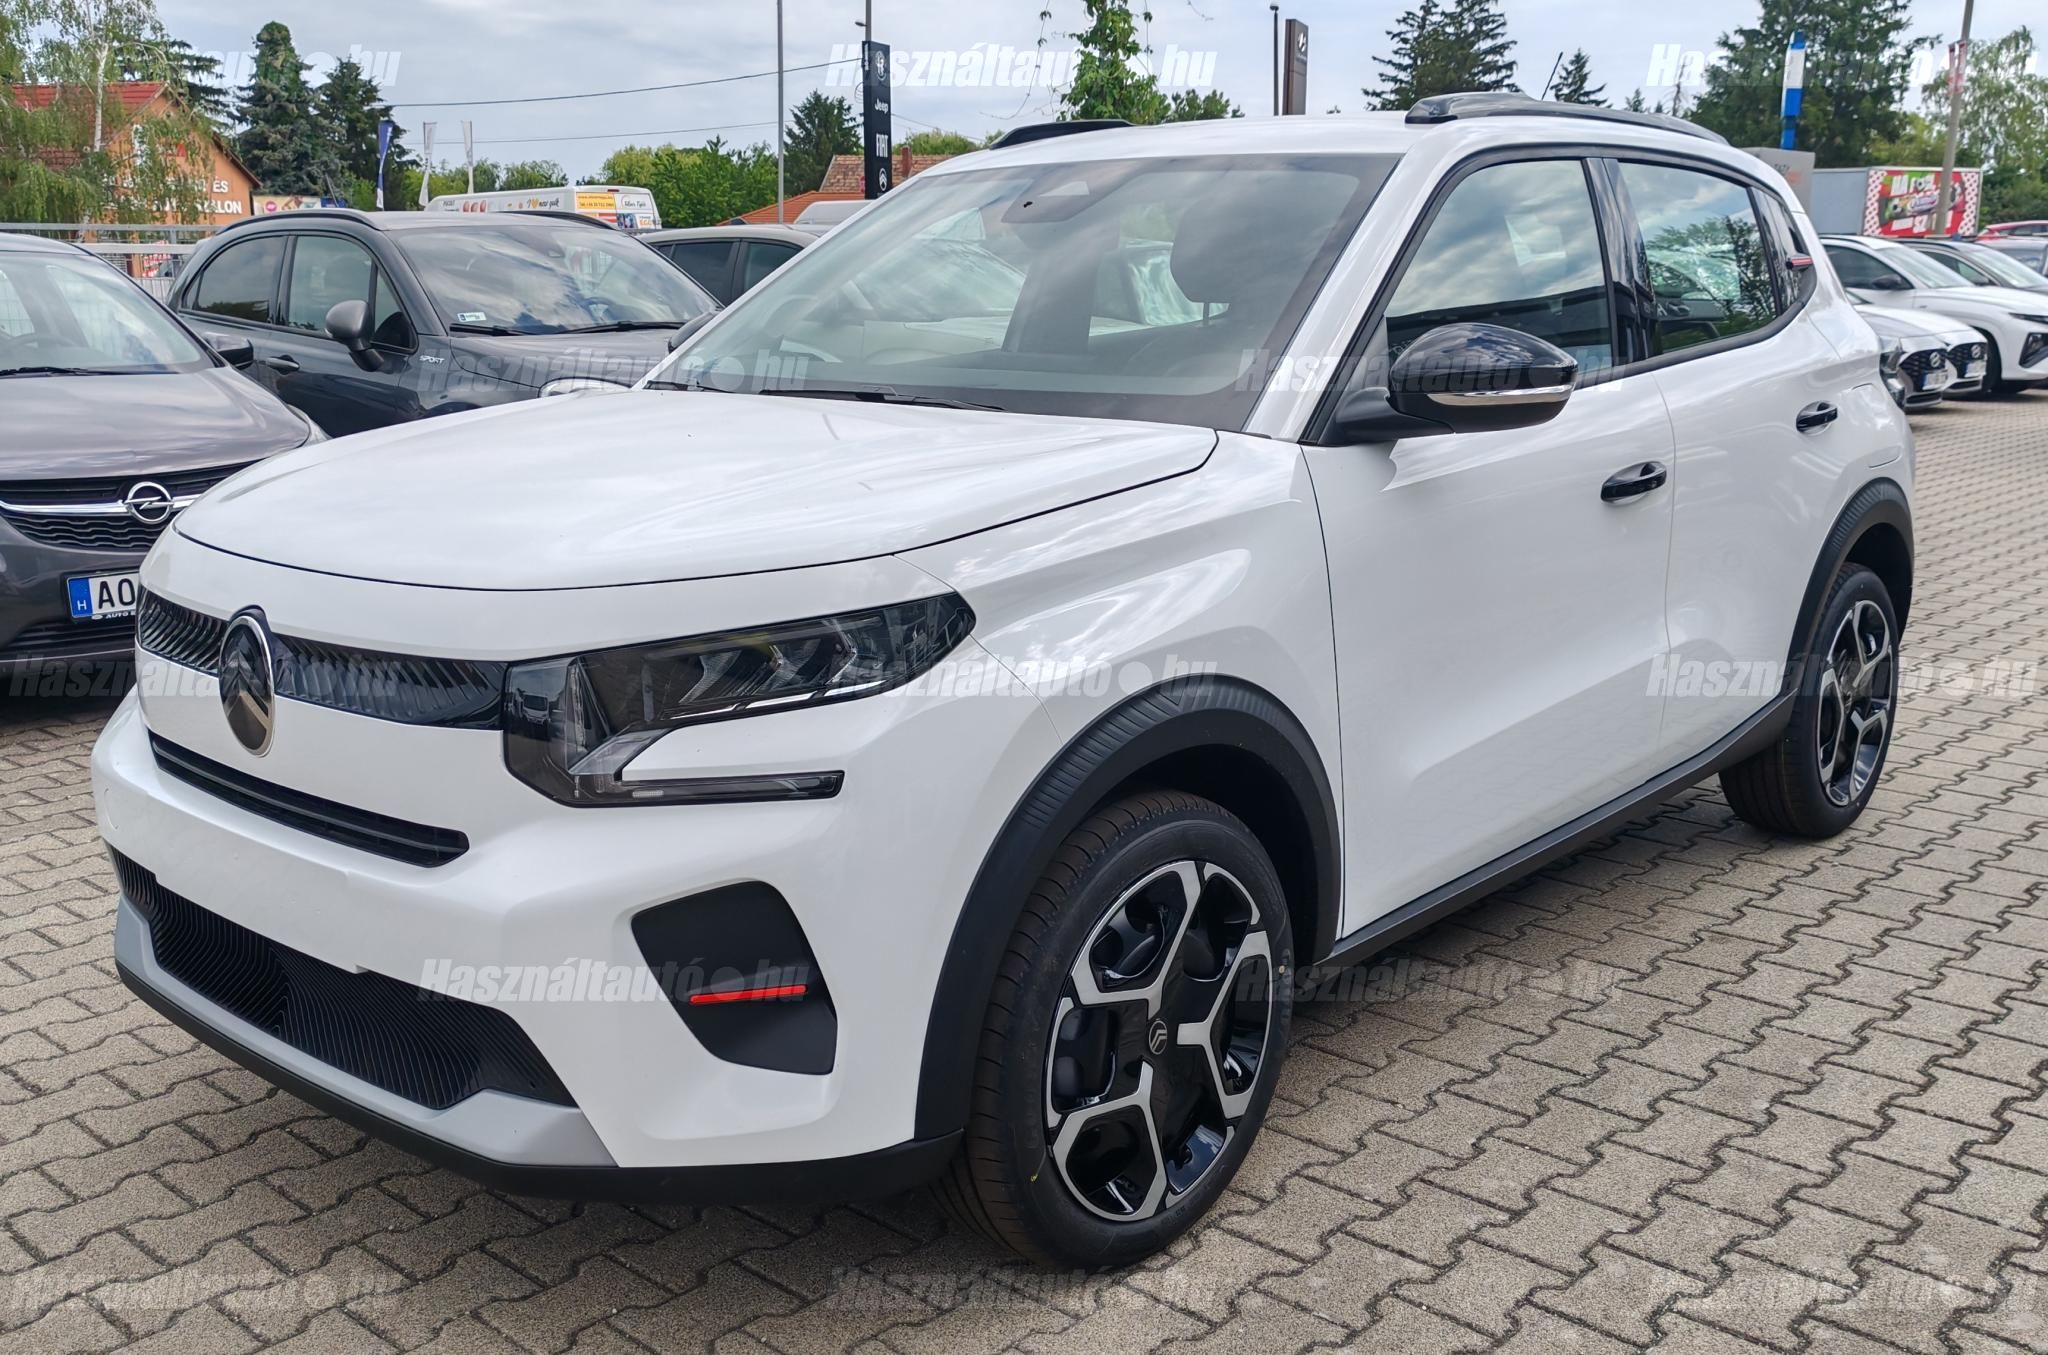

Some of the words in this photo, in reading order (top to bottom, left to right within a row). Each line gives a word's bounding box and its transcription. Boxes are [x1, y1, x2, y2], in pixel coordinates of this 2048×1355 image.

[875, 98, 889, 114] Jeep
[876, 133, 889, 158] FIAT
[419, 354, 446, 365] SPORT
[77, 599, 88, 611] H
